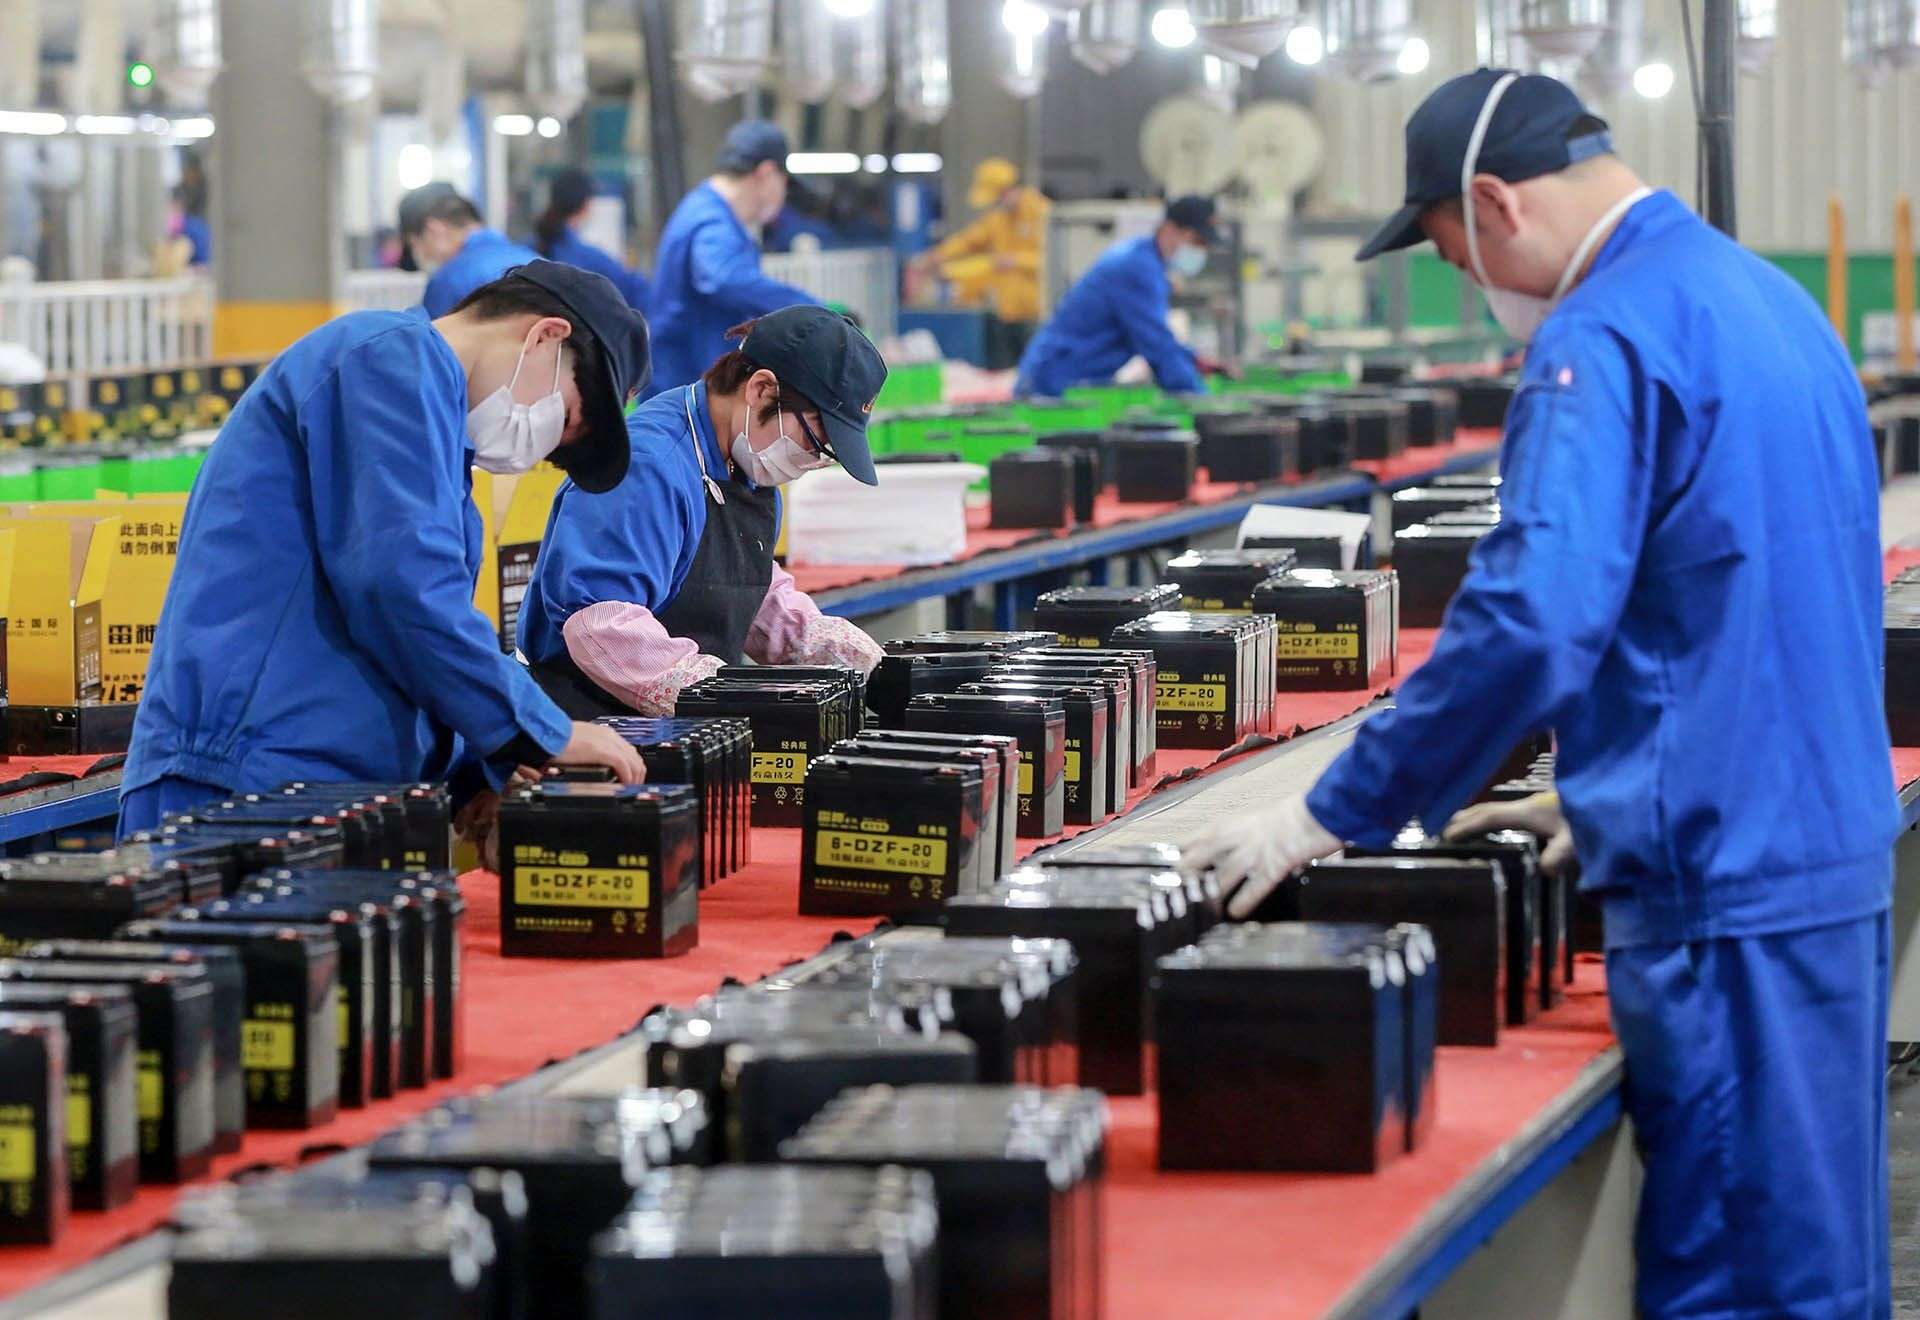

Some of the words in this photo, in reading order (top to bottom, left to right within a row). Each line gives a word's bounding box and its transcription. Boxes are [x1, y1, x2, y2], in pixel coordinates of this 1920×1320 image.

[120, 522, 178, 536] 此面向上
[121, 541, 177, 555] 请勿倒置
[752, 757, 794, 769] F-20
[530, 873, 634, 889] 6-DZF-20
